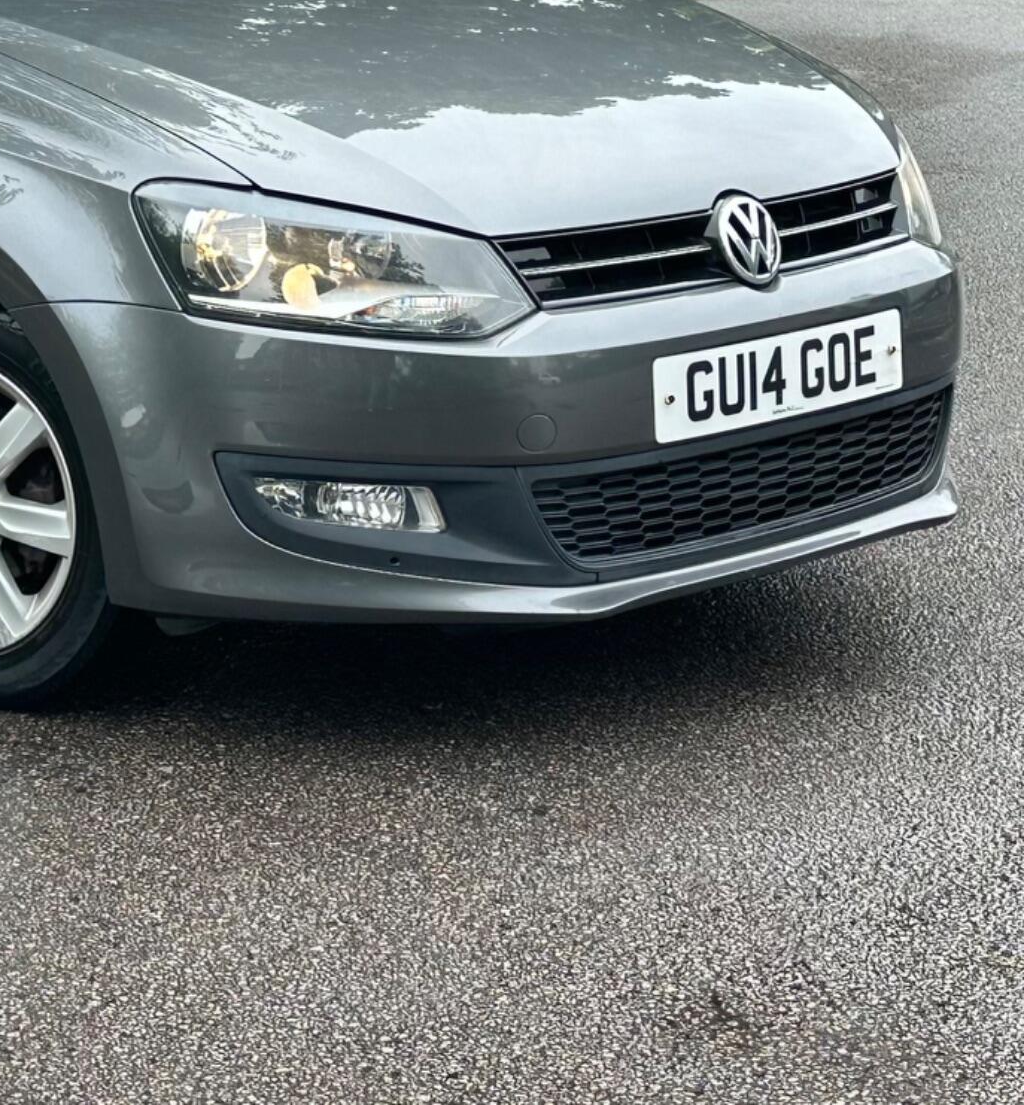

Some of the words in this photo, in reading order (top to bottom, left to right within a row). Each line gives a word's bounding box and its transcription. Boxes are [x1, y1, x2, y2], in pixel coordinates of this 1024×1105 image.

[722, 198, 778, 281] VW
[686, 346, 786, 422] GU14
[800, 325, 876, 398] GOE
